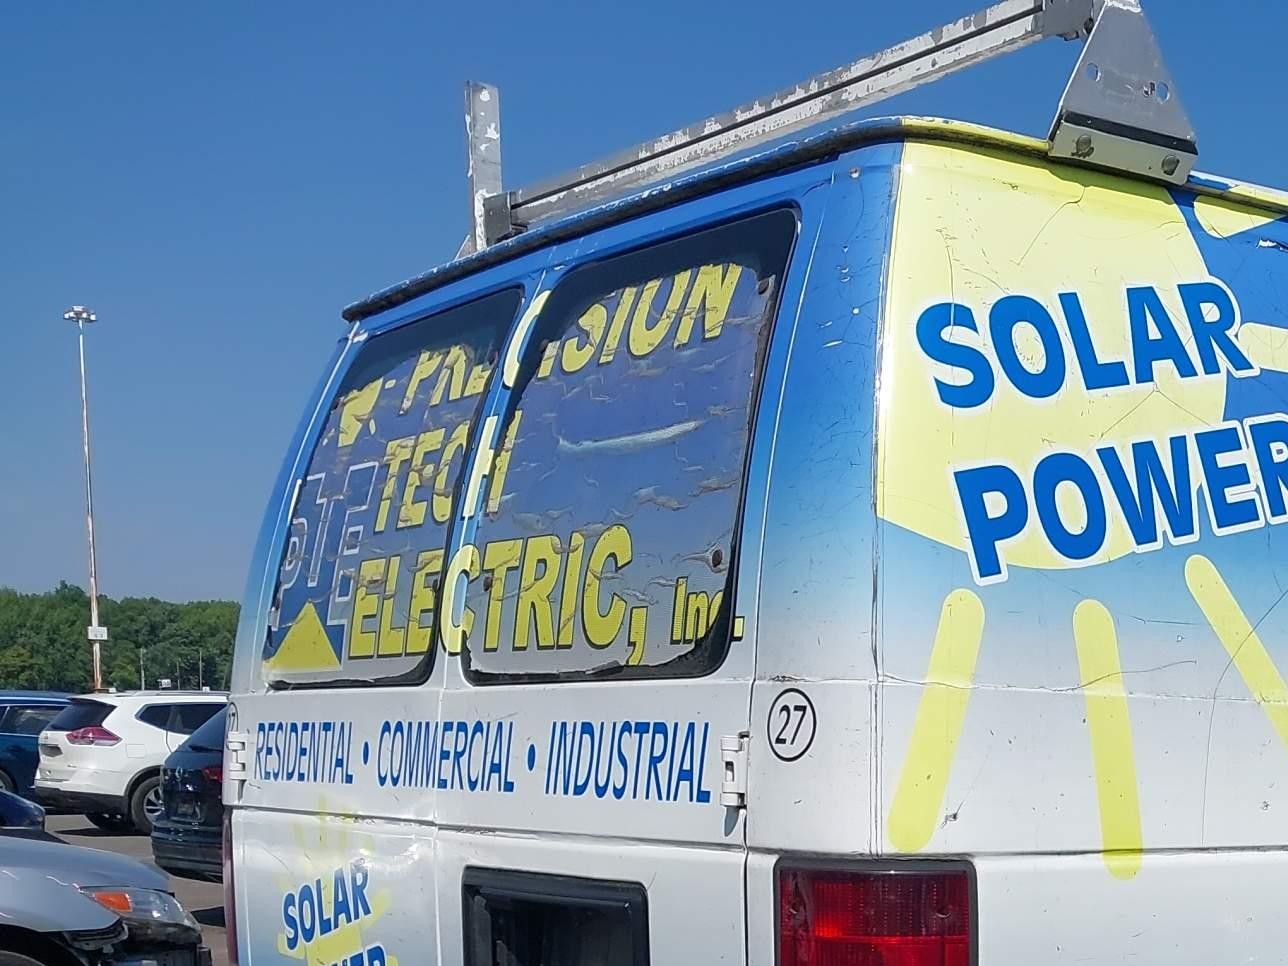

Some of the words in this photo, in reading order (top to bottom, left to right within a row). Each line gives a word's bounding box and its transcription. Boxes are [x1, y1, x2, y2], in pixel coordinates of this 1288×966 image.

[915, 281, 1256, 410] SOLAR
[374, 408, 523, 533] TECH
[347, 525, 648, 667] ELECTRIC,
[254, 720, 354, 786] RESIDENTIAL
[376, 720, 516, 794] COMMERCIAL
[545, 720, 712, 805] INDUSTRIAL
[774, 705, 807, 745] 27
[281, 857, 372, 952] SOLAR
